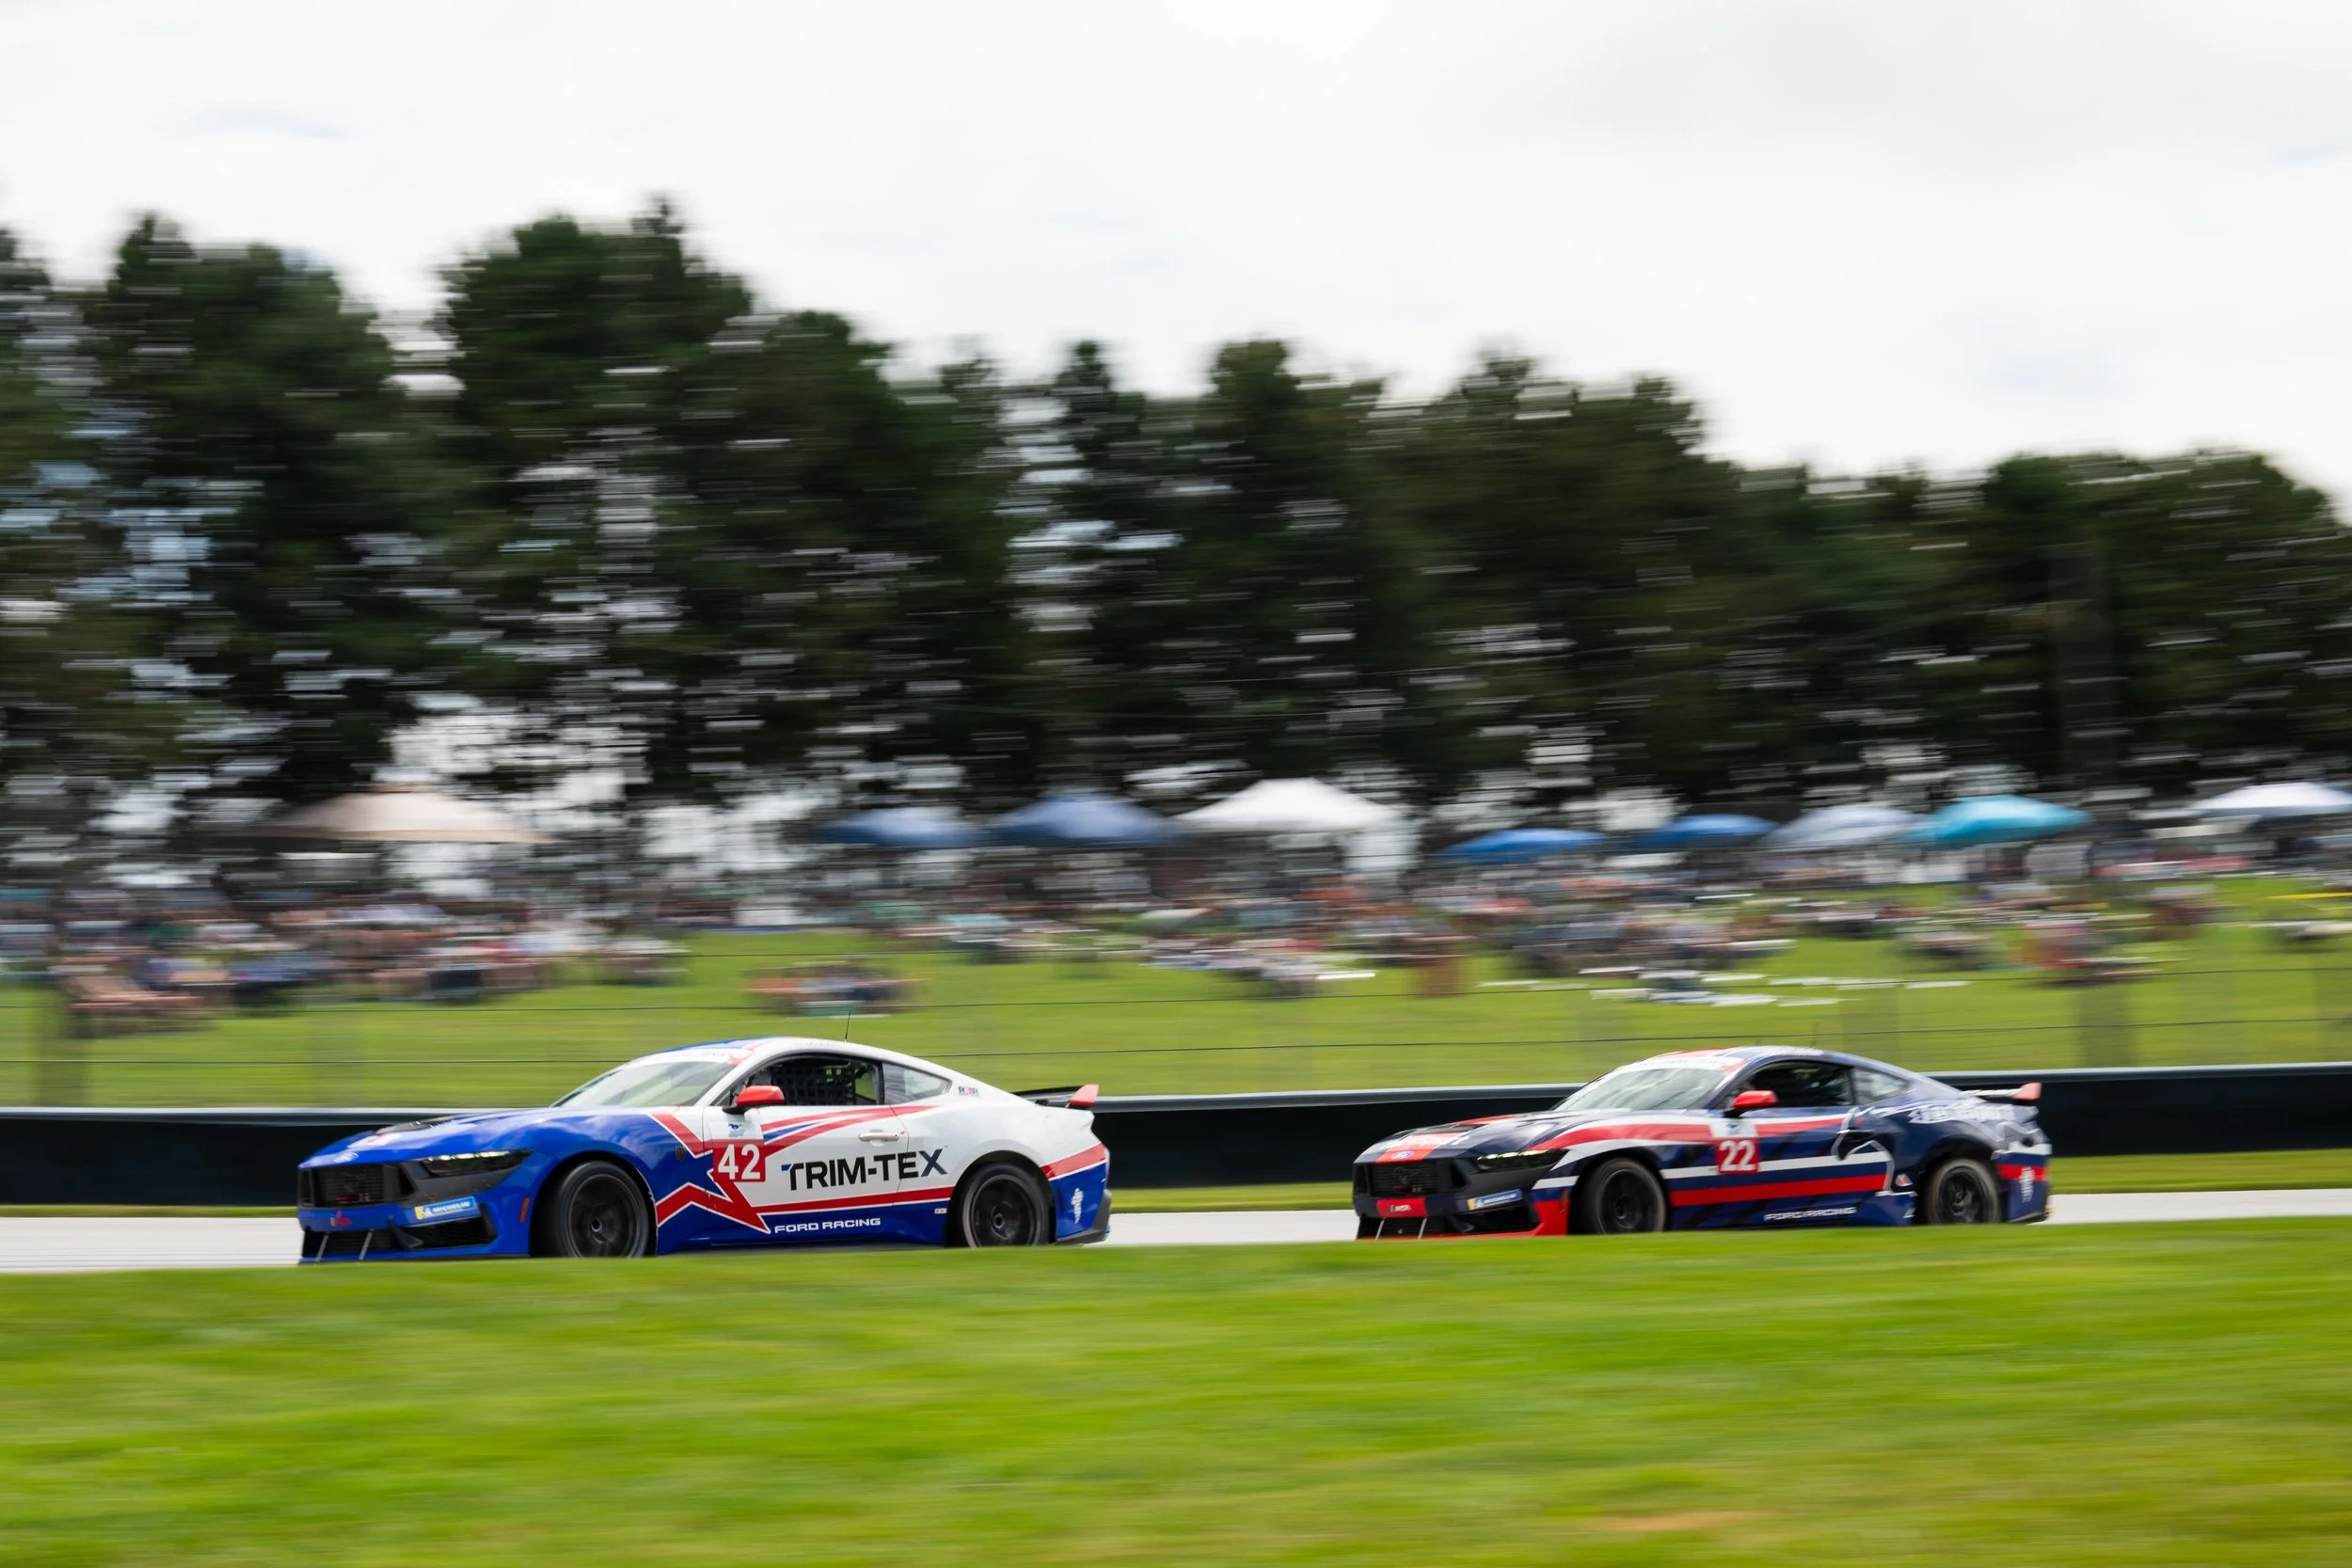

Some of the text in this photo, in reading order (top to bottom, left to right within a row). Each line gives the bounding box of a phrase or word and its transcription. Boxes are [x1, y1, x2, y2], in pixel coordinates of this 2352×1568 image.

[718, 1143, 761, 1180] 42
[781, 1148, 947, 1191] TRIM-TEX
[1719, 1139, 1756, 1172] 22
[774, 1218, 882, 1234] FORD RACING
